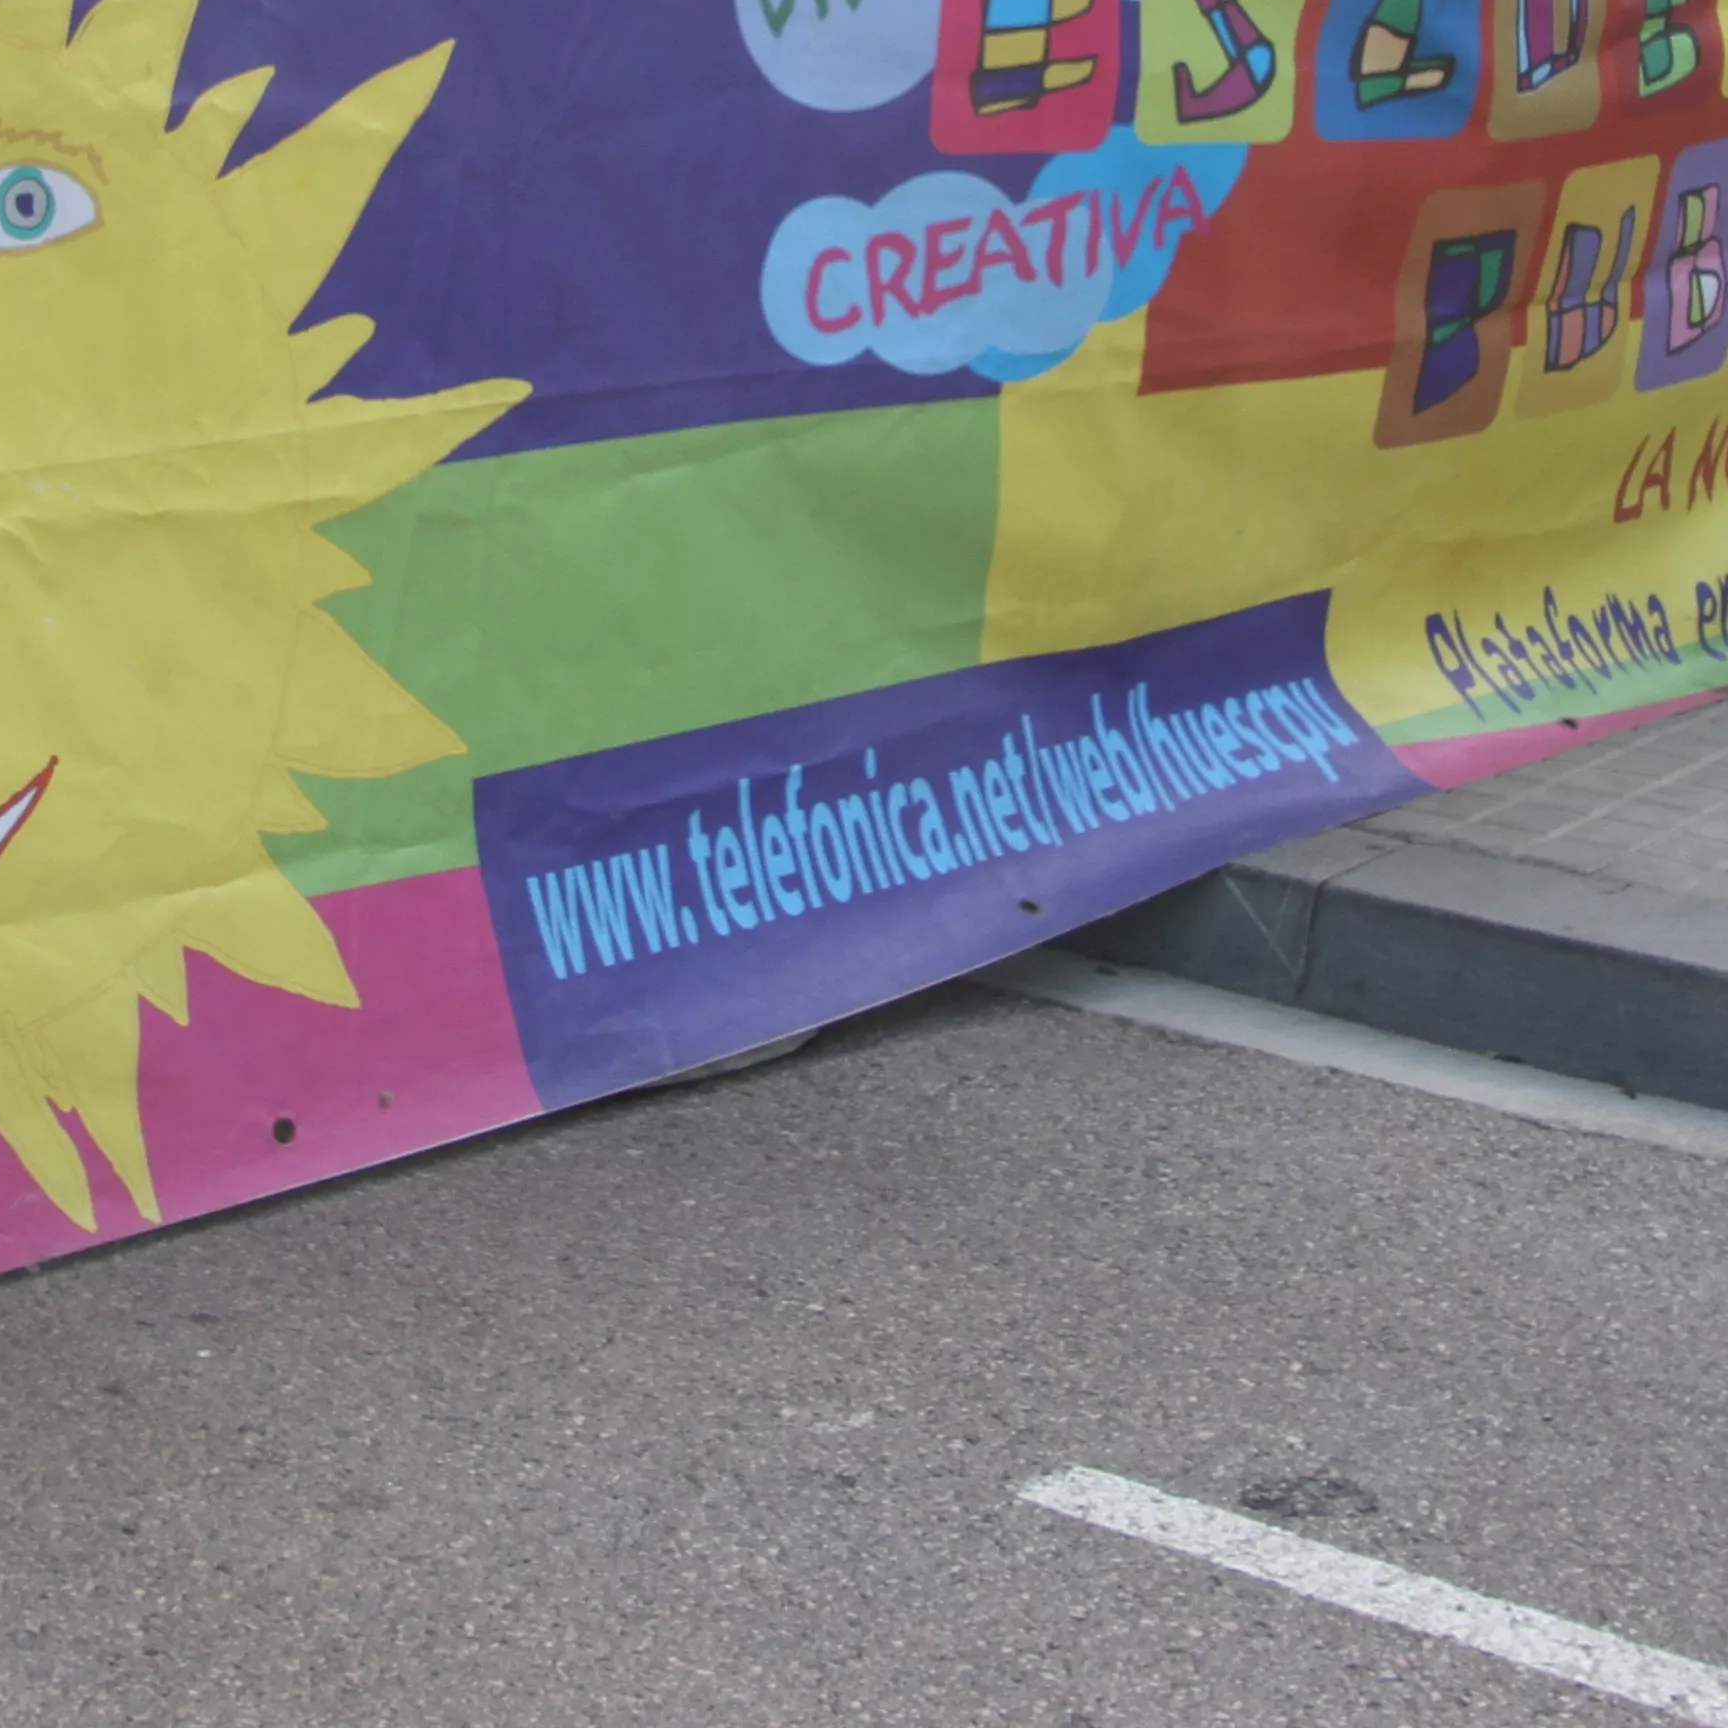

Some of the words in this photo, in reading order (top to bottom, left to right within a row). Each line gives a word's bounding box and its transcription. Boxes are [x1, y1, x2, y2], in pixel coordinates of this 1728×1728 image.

[803, 163, 1213, 336] CREATIVA
[1613, 425, 1676, 524] LA
[1424, 584, 1684, 724] Plataforma
[526, 676, 1360, 980] www.telefonica.net/web/huescpu
